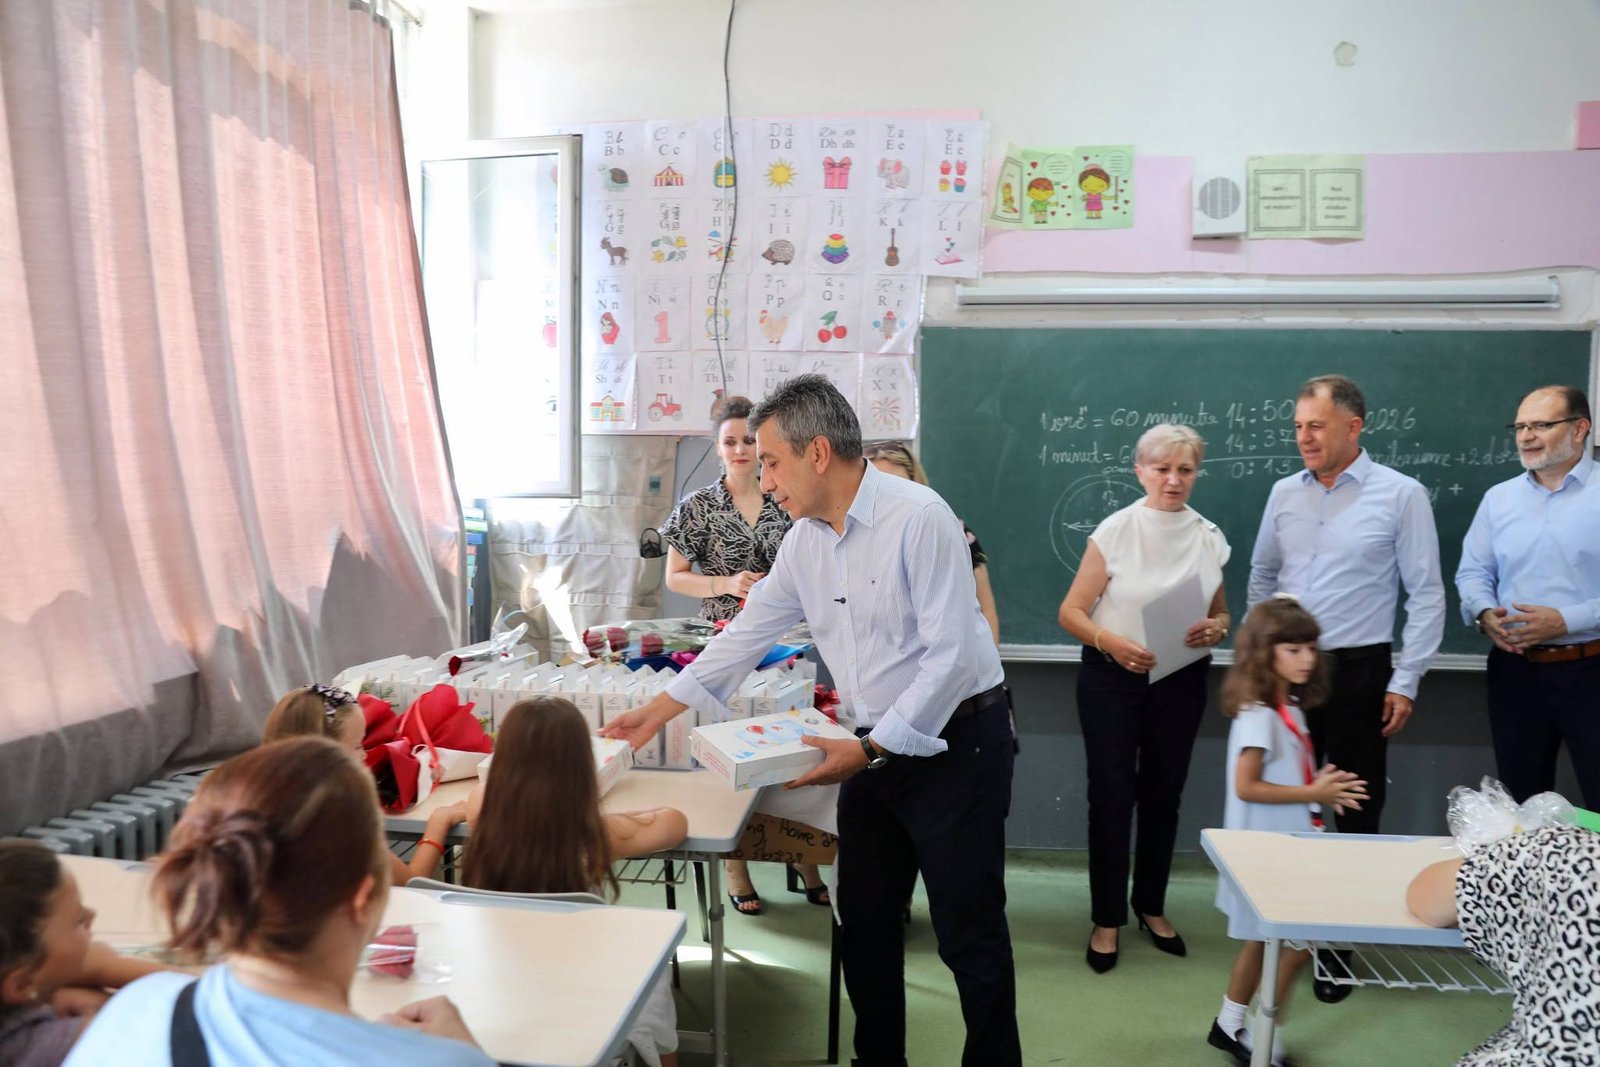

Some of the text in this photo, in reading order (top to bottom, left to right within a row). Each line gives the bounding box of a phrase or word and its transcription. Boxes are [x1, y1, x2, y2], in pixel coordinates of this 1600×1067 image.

[659, 144, 681, 156] C c
[770, 138, 793, 151] D d
[820, 138, 837, 150] Dh
[885, 139, 895, 151] E
[604, 144, 625, 157] B b
[605, 222, 615, 233] G
[712, 216, 721, 227] H
[878, 217, 888, 228] K
[765, 293, 786, 307] P p
[822, 290, 832, 302] Q
[877, 295, 887, 307] R
[598, 299, 619, 311] N n
[657, 374, 666, 384] T
[872, 379, 882, 391] X
[1040, 411, 1047, 431] 1
[1110, 407, 1140, 427] 60
[1361, 407, 1417, 434] 2026
[1039, 444, 1047, 467] 1
[1051, 441, 1103, 464] minut
